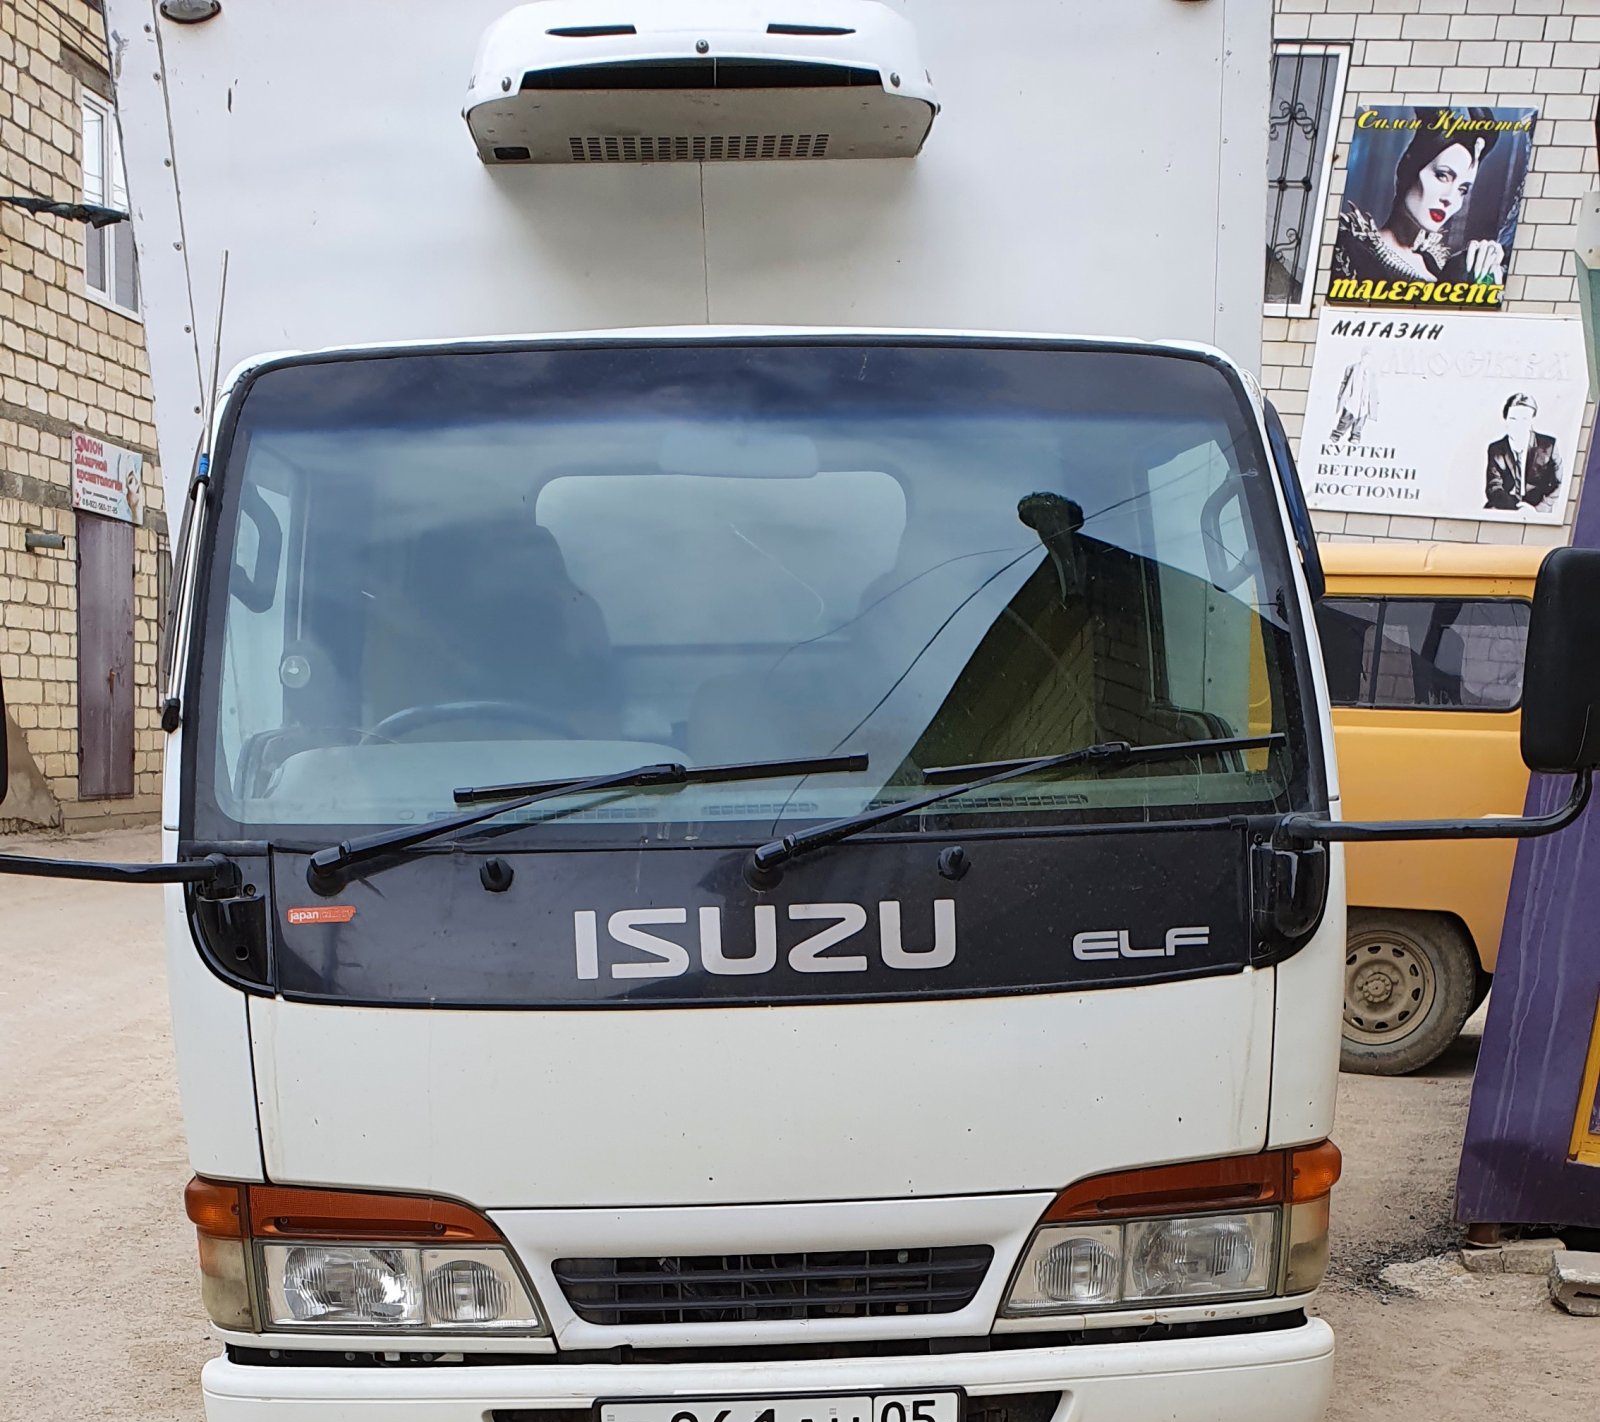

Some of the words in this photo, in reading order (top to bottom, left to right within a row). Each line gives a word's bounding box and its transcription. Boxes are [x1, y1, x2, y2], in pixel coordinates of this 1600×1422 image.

[1357, 109, 1422, 130] Салон
[1331, 320, 1444, 341] МАГАЗИН
[1320, 443, 1396, 460] КУРТКИ
[1317, 463, 1417, 481] ВЕТРОВКИ
[1314, 482, 1421, 501] КОСТЮМЫ
[290, 909, 319, 923] japan
[574, 898, 957, 980] ISUZU
[1072, 926, 1210, 961] ELF
